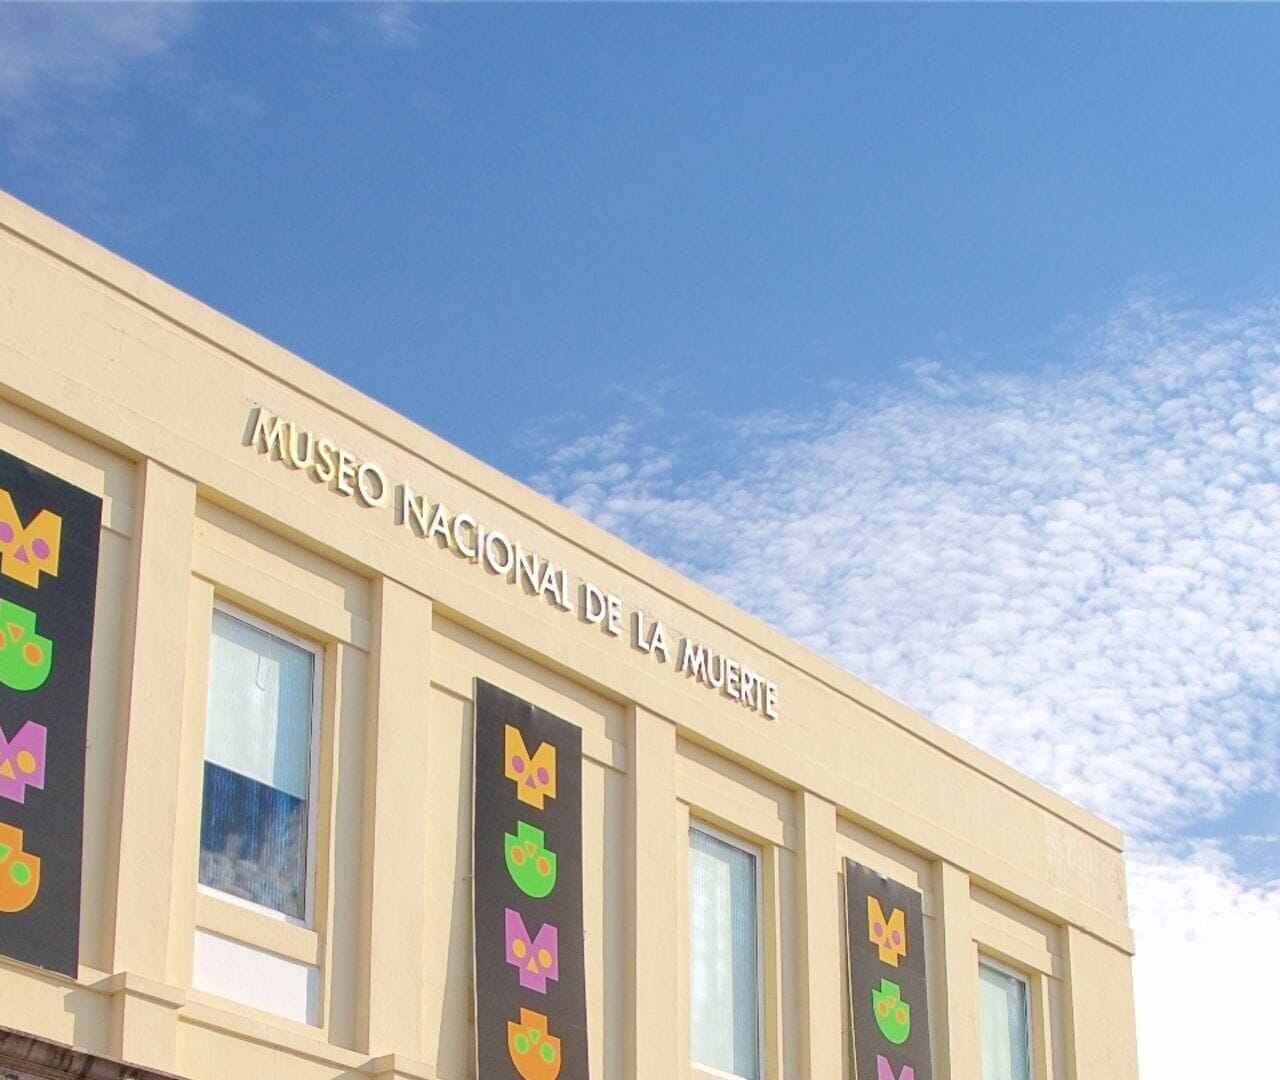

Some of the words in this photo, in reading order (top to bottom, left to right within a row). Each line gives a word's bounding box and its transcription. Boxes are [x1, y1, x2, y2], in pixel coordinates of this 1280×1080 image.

[247, 405, 388, 508] MUSEO
[401, 481, 574, 613] NACIONAL
[584, 581, 623, 637] DE
[636, 609, 670, 663] LA
[680, 637, 780, 721] MUERTE
